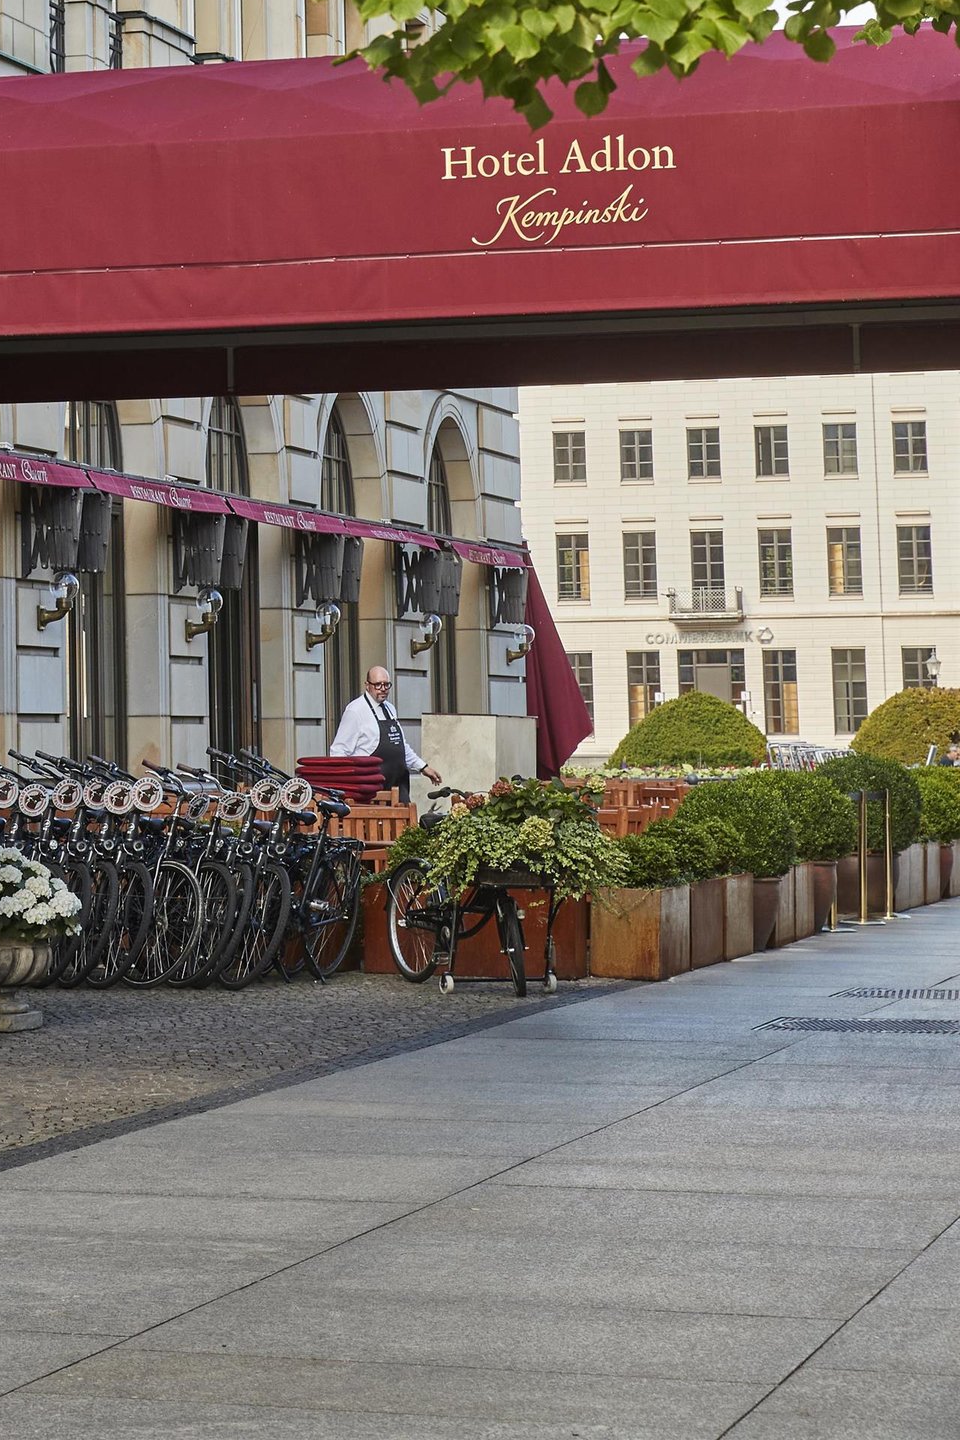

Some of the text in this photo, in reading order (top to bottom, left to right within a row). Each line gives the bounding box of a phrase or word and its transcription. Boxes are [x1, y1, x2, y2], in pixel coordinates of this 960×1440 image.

[441, 134, 677, 180] Hotel Adlon
[471, 184, 649, 246] Kempinski
[645, 630, 753, 645] COMMERZBANK
